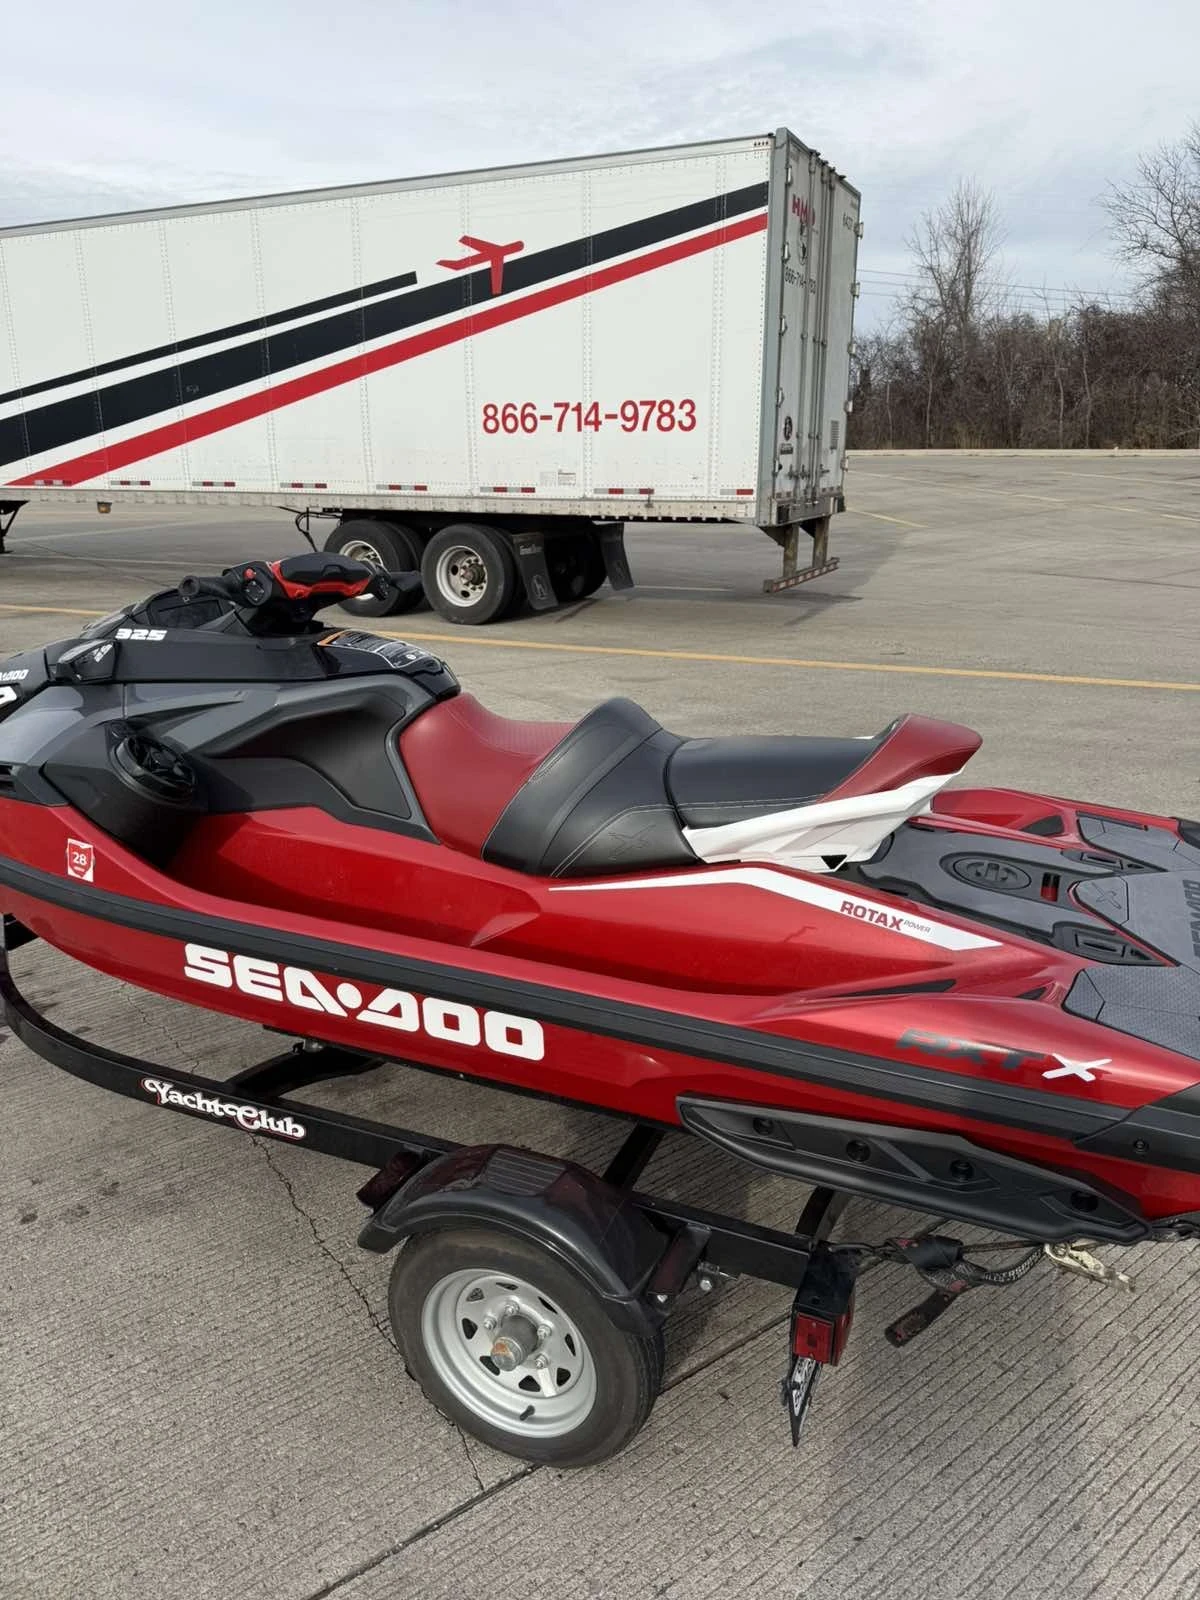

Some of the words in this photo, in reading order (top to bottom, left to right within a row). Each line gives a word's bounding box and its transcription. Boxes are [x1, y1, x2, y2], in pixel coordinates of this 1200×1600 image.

[482, 399, 697, 434] 866-714-9783
[115, 628, 168, 641] 325
[72, 851, 87, 866] 28
[840, 900, 904, 931] ROTAX
[903, 920, 931, 933] POWER
[1041, 1053, 1113, 1082] X
